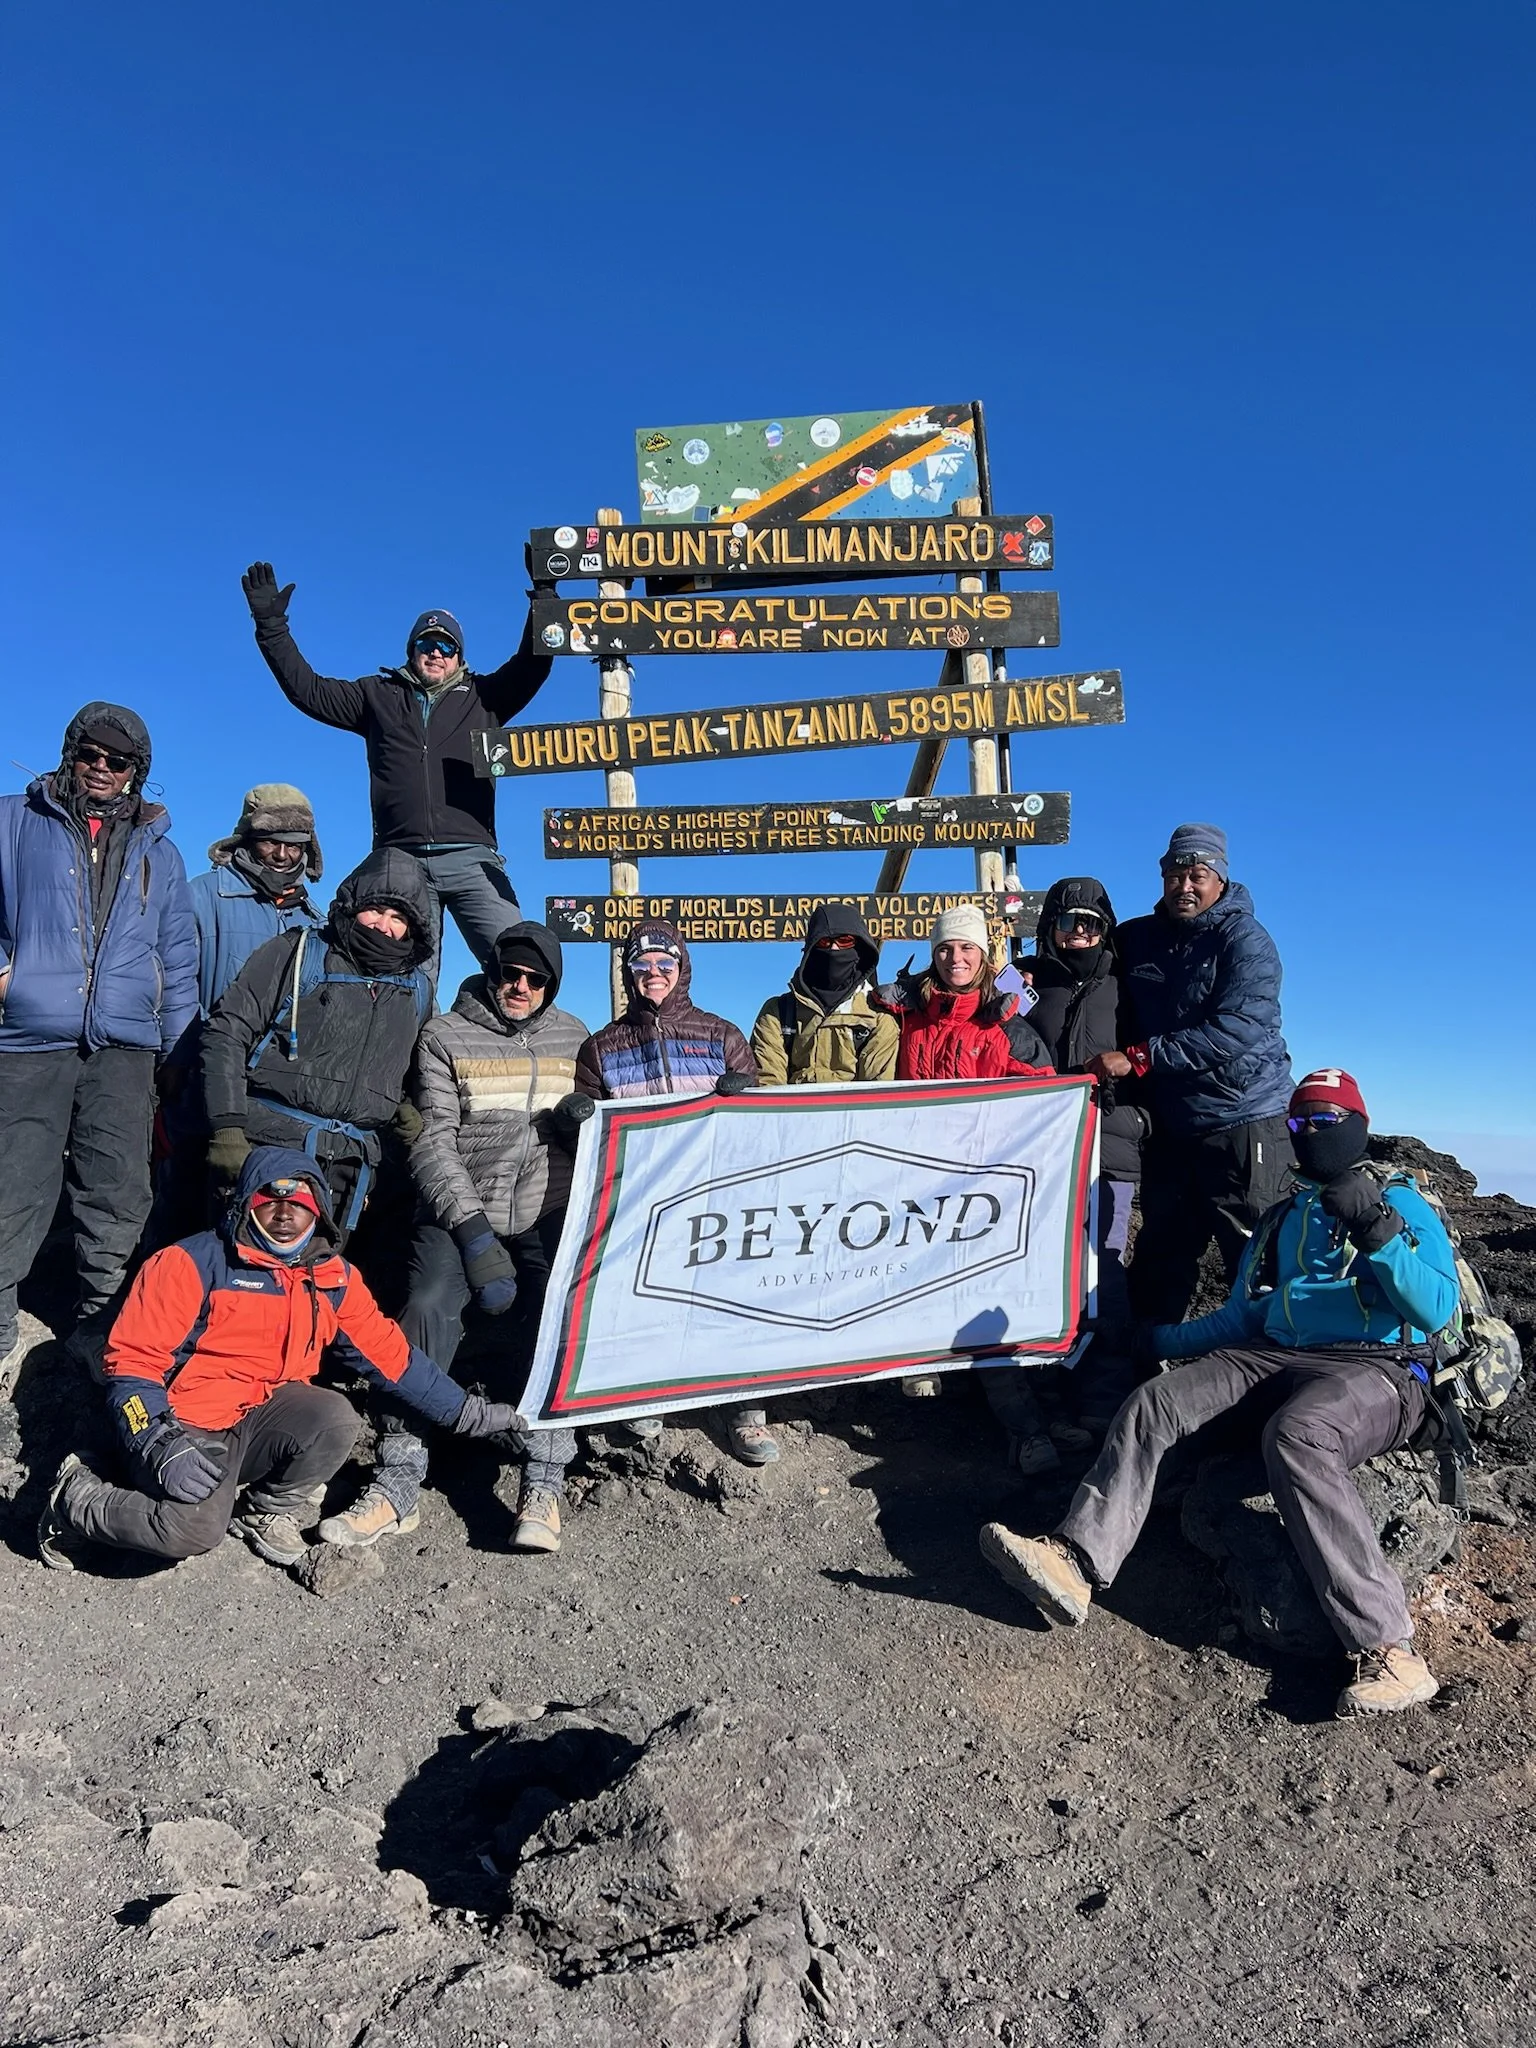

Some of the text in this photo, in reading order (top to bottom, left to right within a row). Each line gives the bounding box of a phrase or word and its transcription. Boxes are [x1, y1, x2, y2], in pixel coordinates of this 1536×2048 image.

[605, 529, 732, 567] MOUNT
[747, 523, 995, 564] KILIMANJARO
[567, 596, 1012, 624] CONGRATULATIONS
[655, 626, 946, 649] YOU ARE NOW AT
[510, 724, 619, 768] UHURU
[887, 688, 996, 736] 5895M
[1005, 681, 1090, 726] AMSL
[677, 811, 764, 830] HIGHEST
[773, 808, 831, 827] POINT
[578, 820, 1035, 851] WORLD'S HIGHEST FREE STANDING MOUNTAIN
[604, 898, 645, 917] ONE
[649, 898, 674, 917] OF
[677, 919, 776, 939] HERITAGE
[782, 918, 808, 938] AN
[684, 1192, 1001, 1268] BEYOND
[757, 1261, 908, 1288] ADVENTURES
